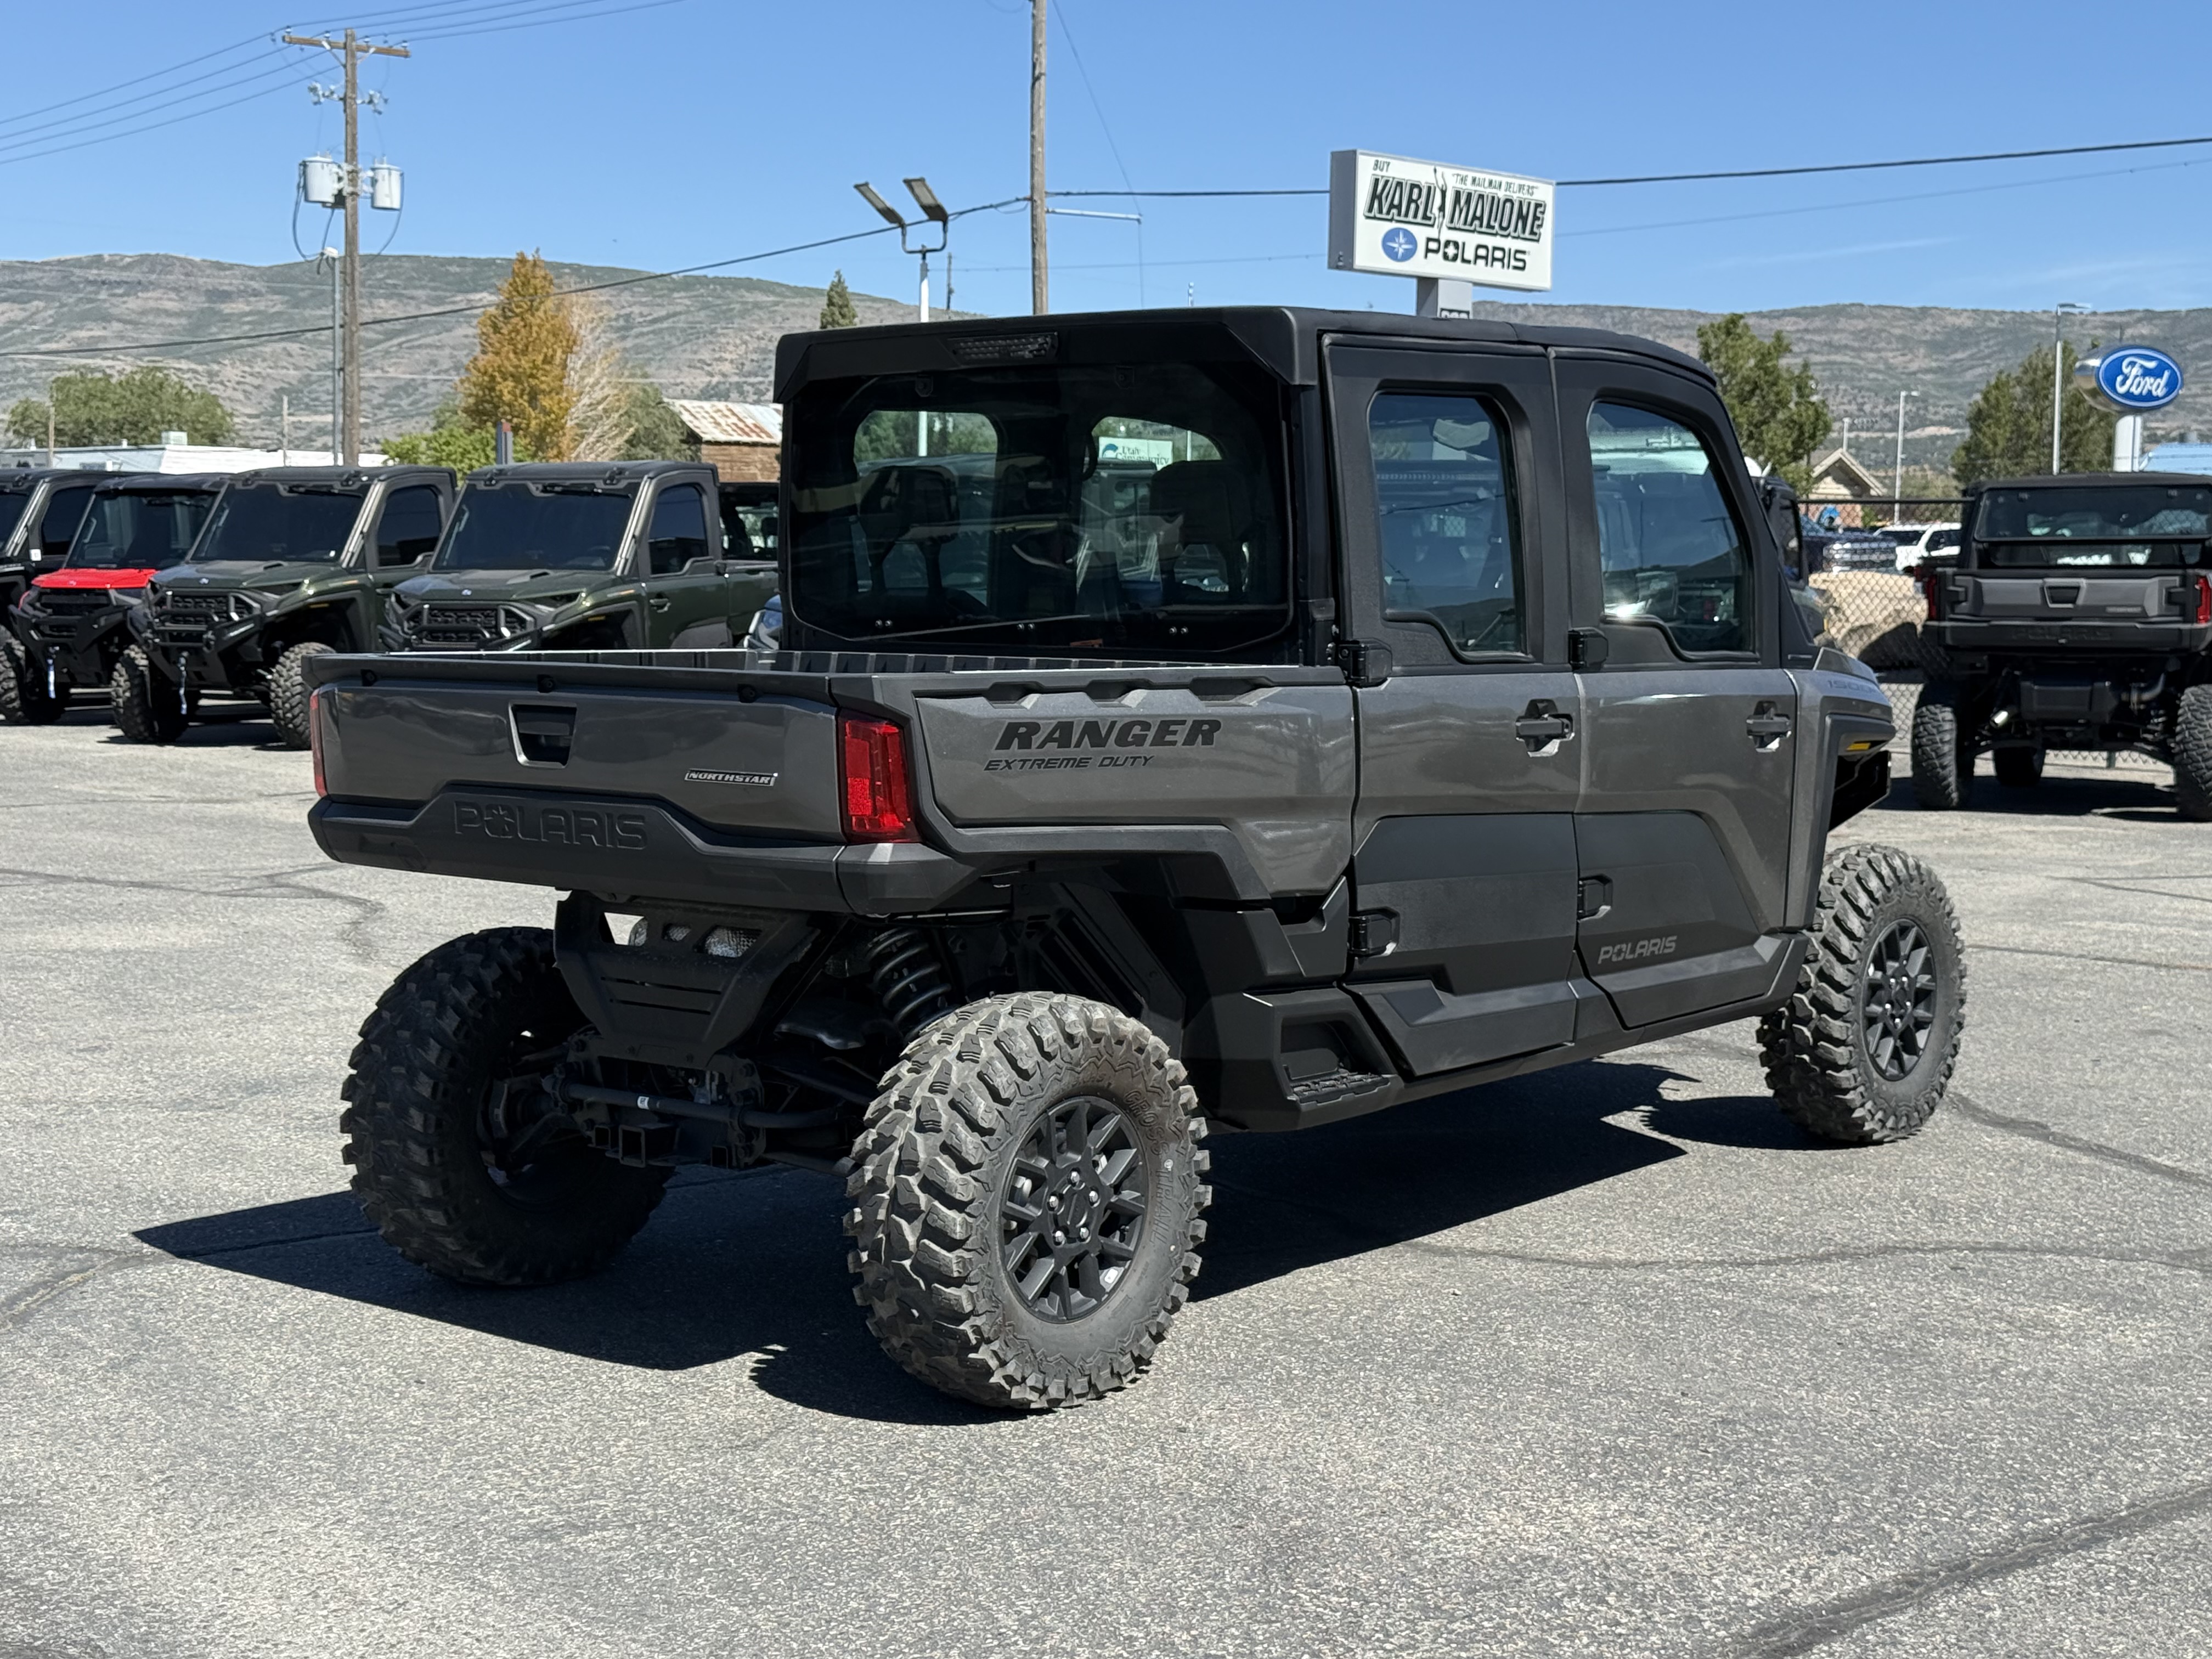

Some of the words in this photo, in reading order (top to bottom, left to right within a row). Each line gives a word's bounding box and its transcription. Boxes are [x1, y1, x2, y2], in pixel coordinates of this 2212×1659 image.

[1373, 159, 1391, 172] BUY
[1470, 176, 1502, 191] MAILMAN
[1363, 173, 1436, 228] KARL
[1446, 187, 1547, 243] MALONE
[1424, 236, 1527, 272] POLARIS
[2115, 356, 2171, 398] Ford
[995, 719, 1222, 751] RANGER
[689, 771, 771, 784] NORTHSTAR
[984, 756, 1092, 771] EXTREME
[1097, 755, 1155, 768] DUTY
[454, 800, 648, 850] POLARIS
[1597, 935, 1678, 964] POLARIS
